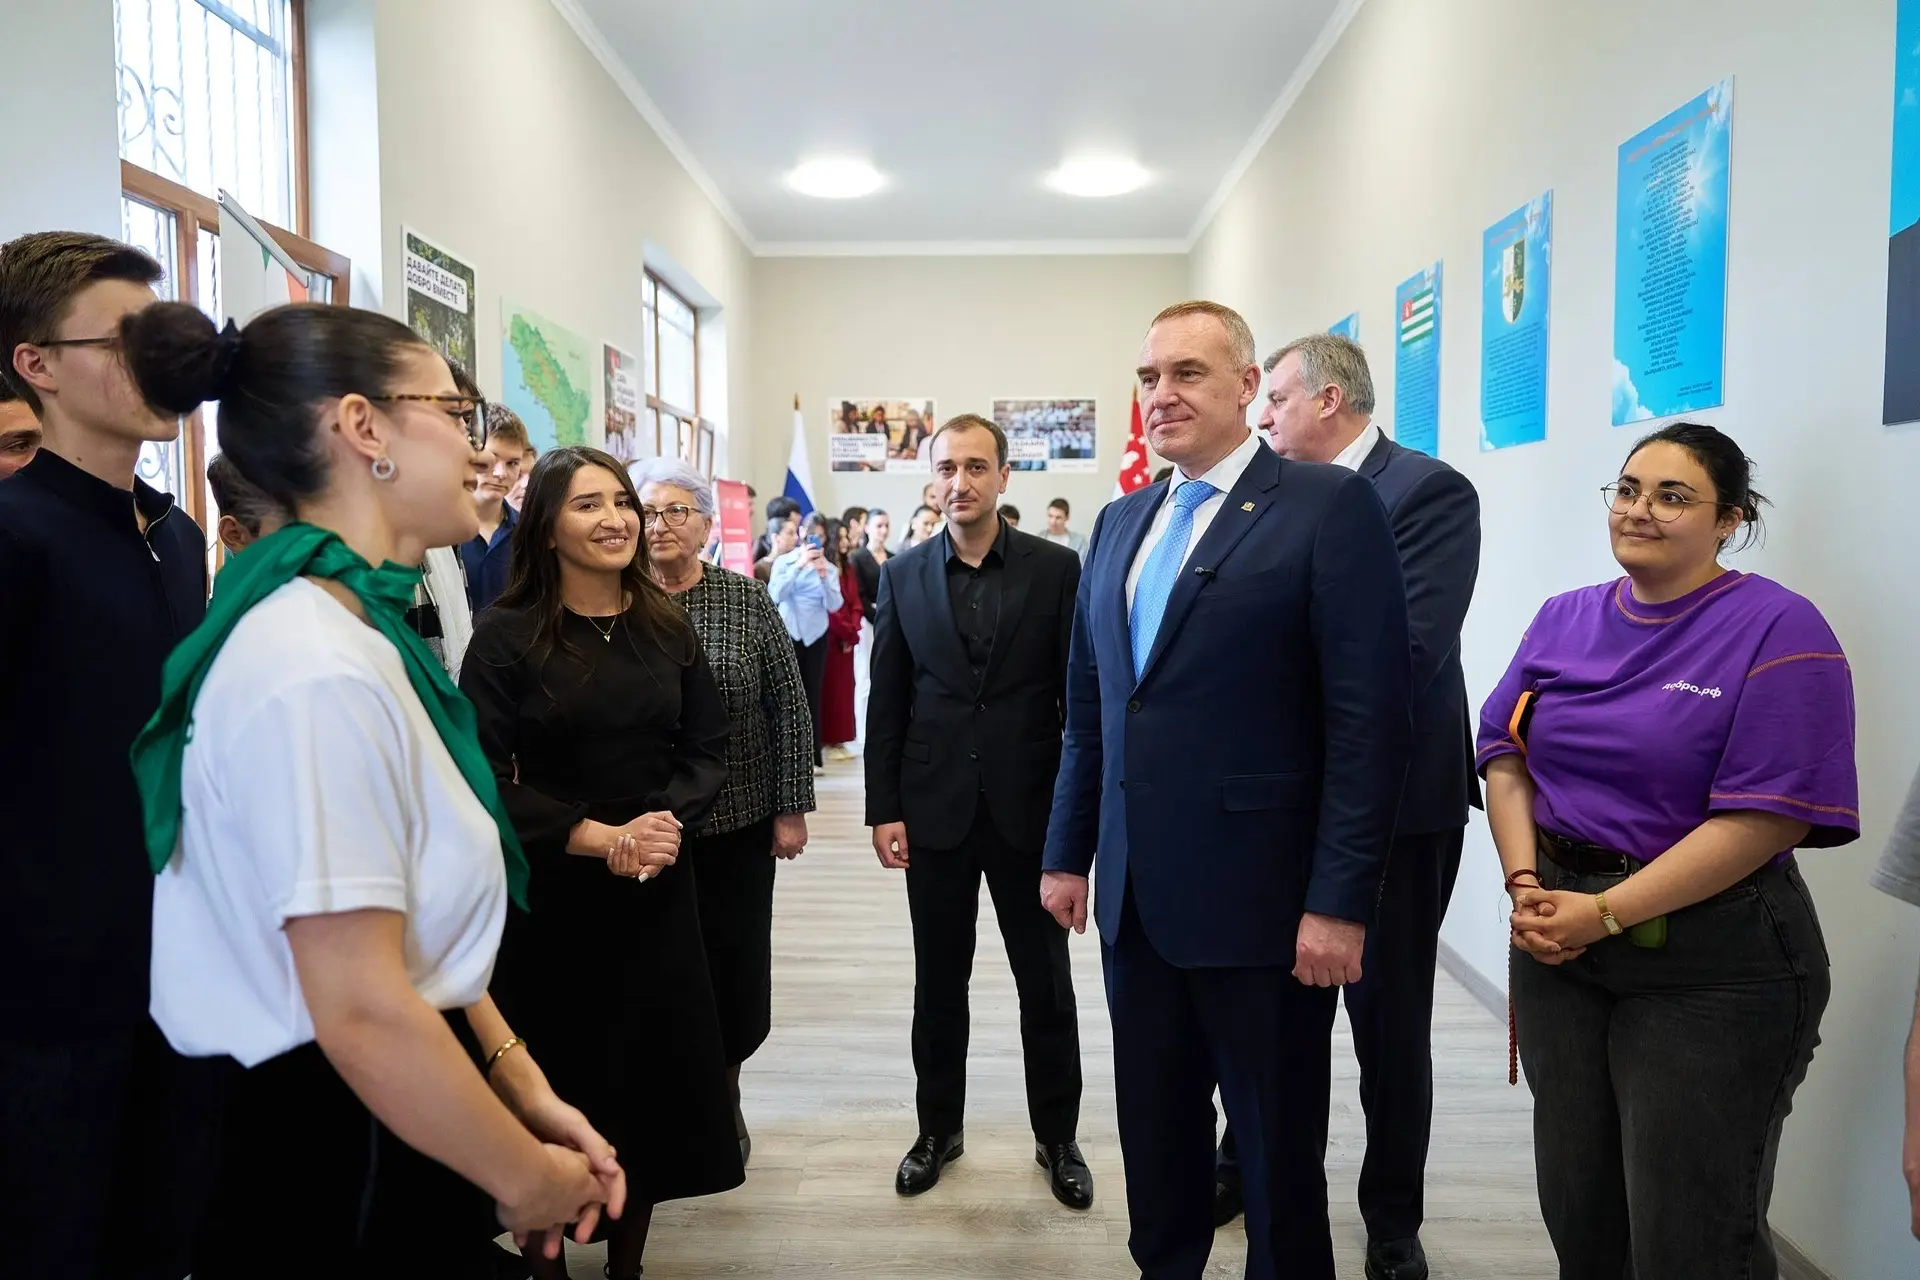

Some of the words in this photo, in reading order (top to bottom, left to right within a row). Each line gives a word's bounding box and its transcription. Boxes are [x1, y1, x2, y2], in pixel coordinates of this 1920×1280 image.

[407, 256, 438, 282] ДАВАЙТЕ
[440, 275, 464, 295] ДЕЛАТЬ
[407, 270, 432, 291] ДОБРО
[433, 284, 459, 304] ВМЕСТЕ
[1662, 680, 1722, 699] добро.рф
